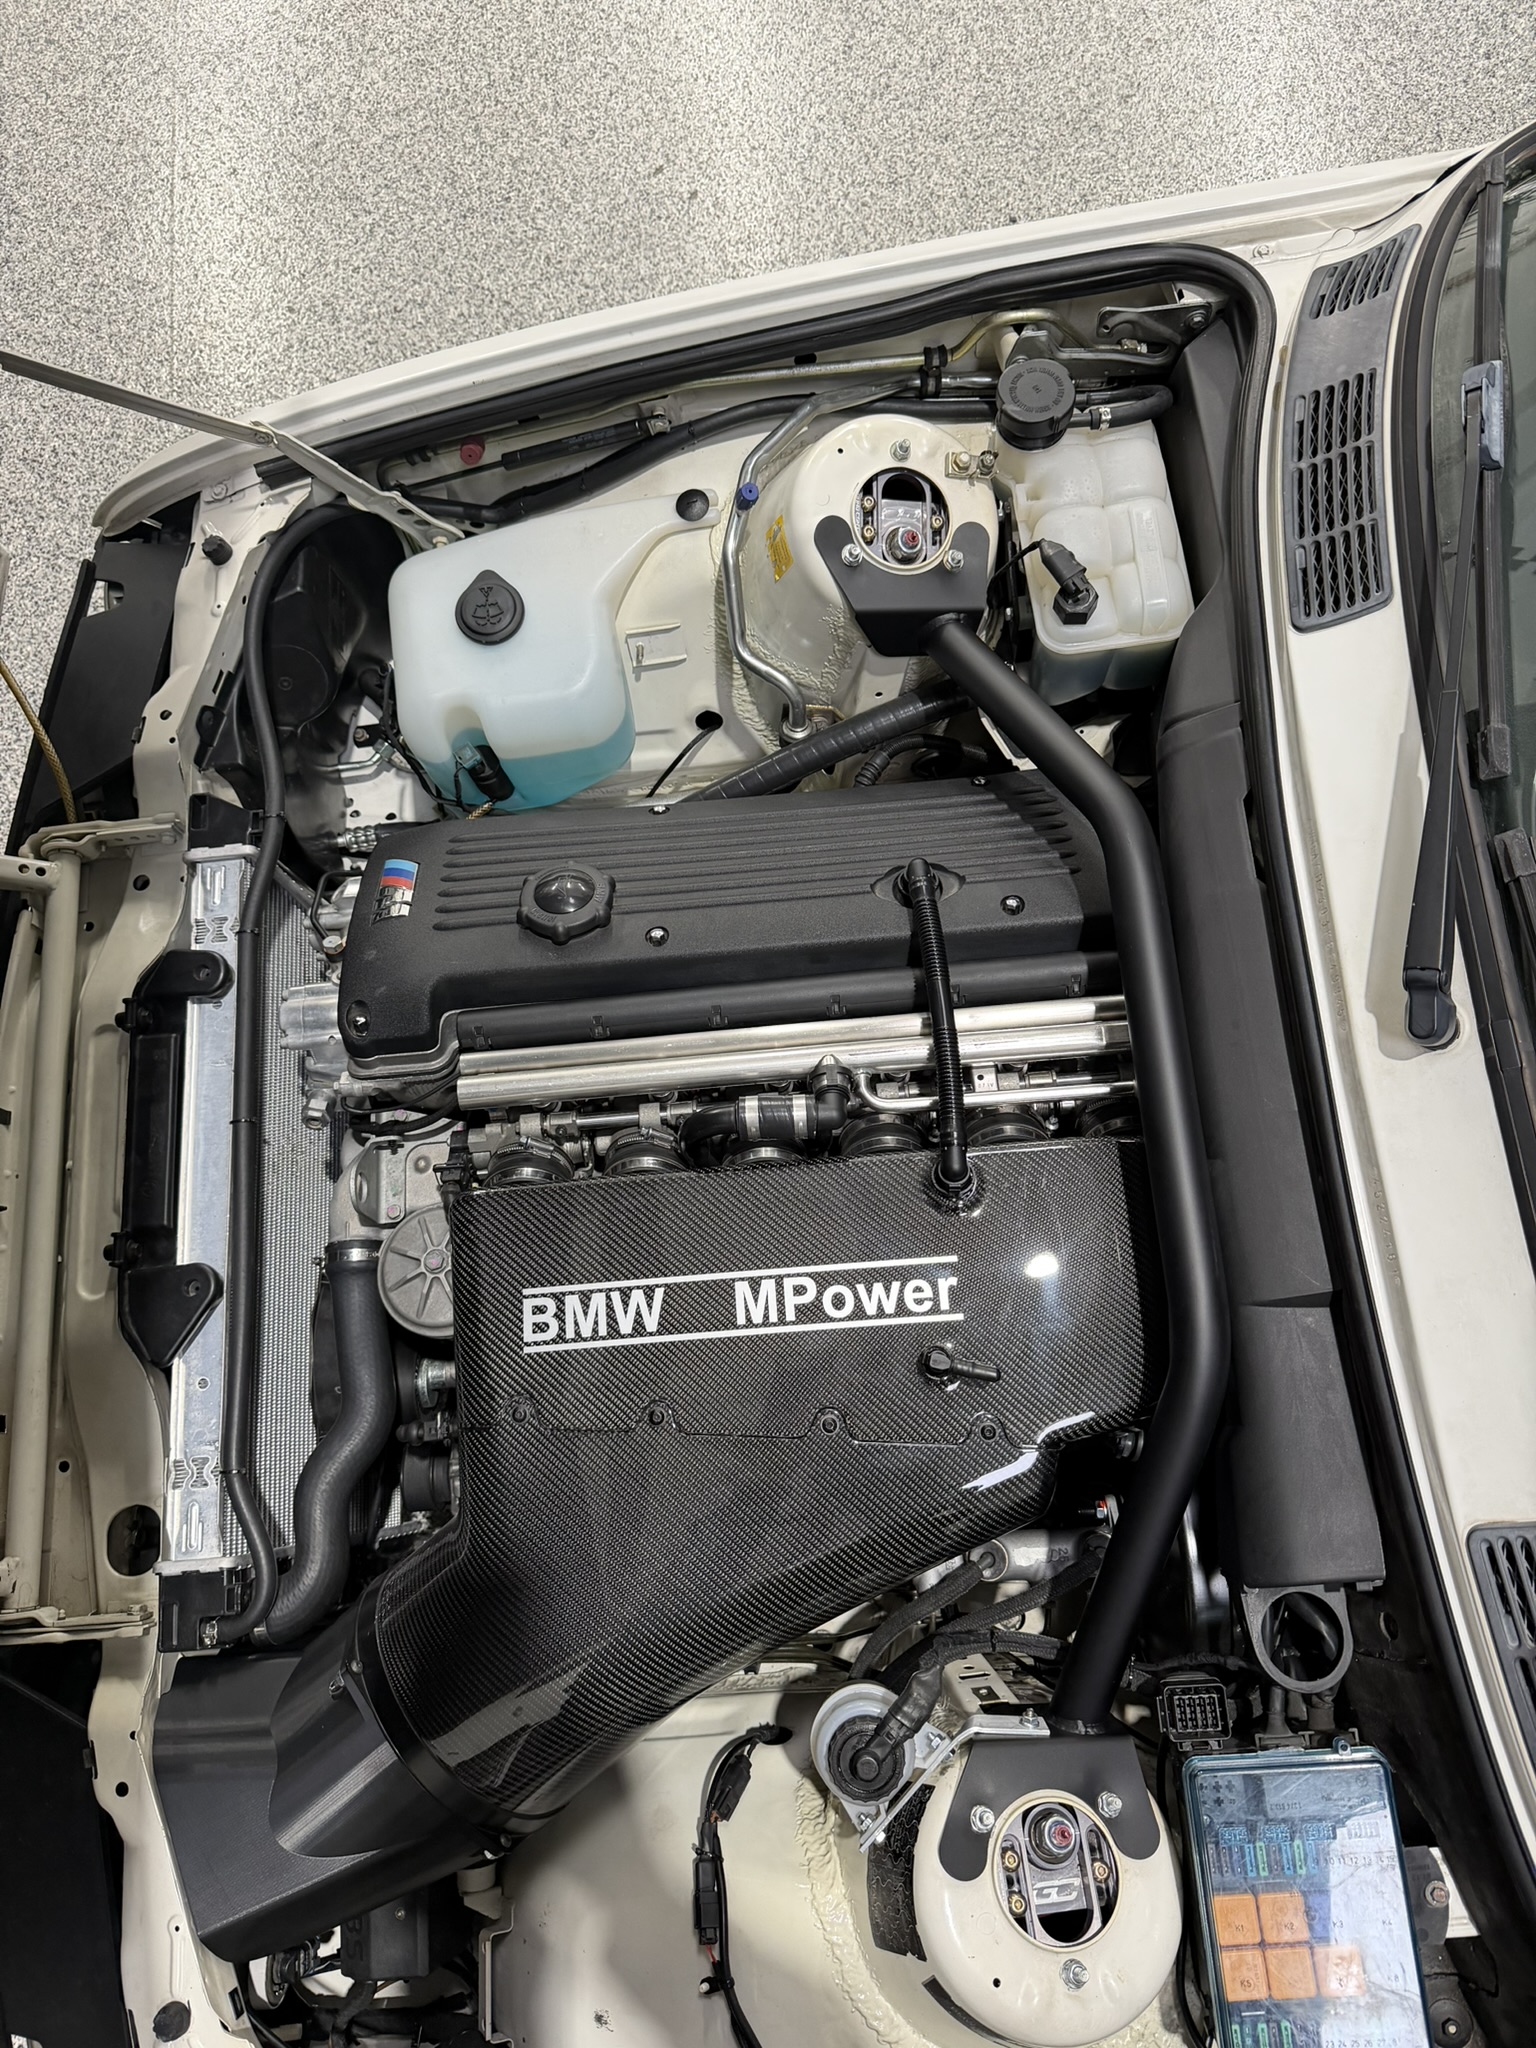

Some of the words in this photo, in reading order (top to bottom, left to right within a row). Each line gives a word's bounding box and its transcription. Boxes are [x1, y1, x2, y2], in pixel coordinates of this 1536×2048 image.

[523, 1287, 665, 1342] BMW
[734, 1275, 959, 1326] MPower
[1235, 1924, 1245, 1932] K1
[1284, 1921, 1296, 1930] K2
